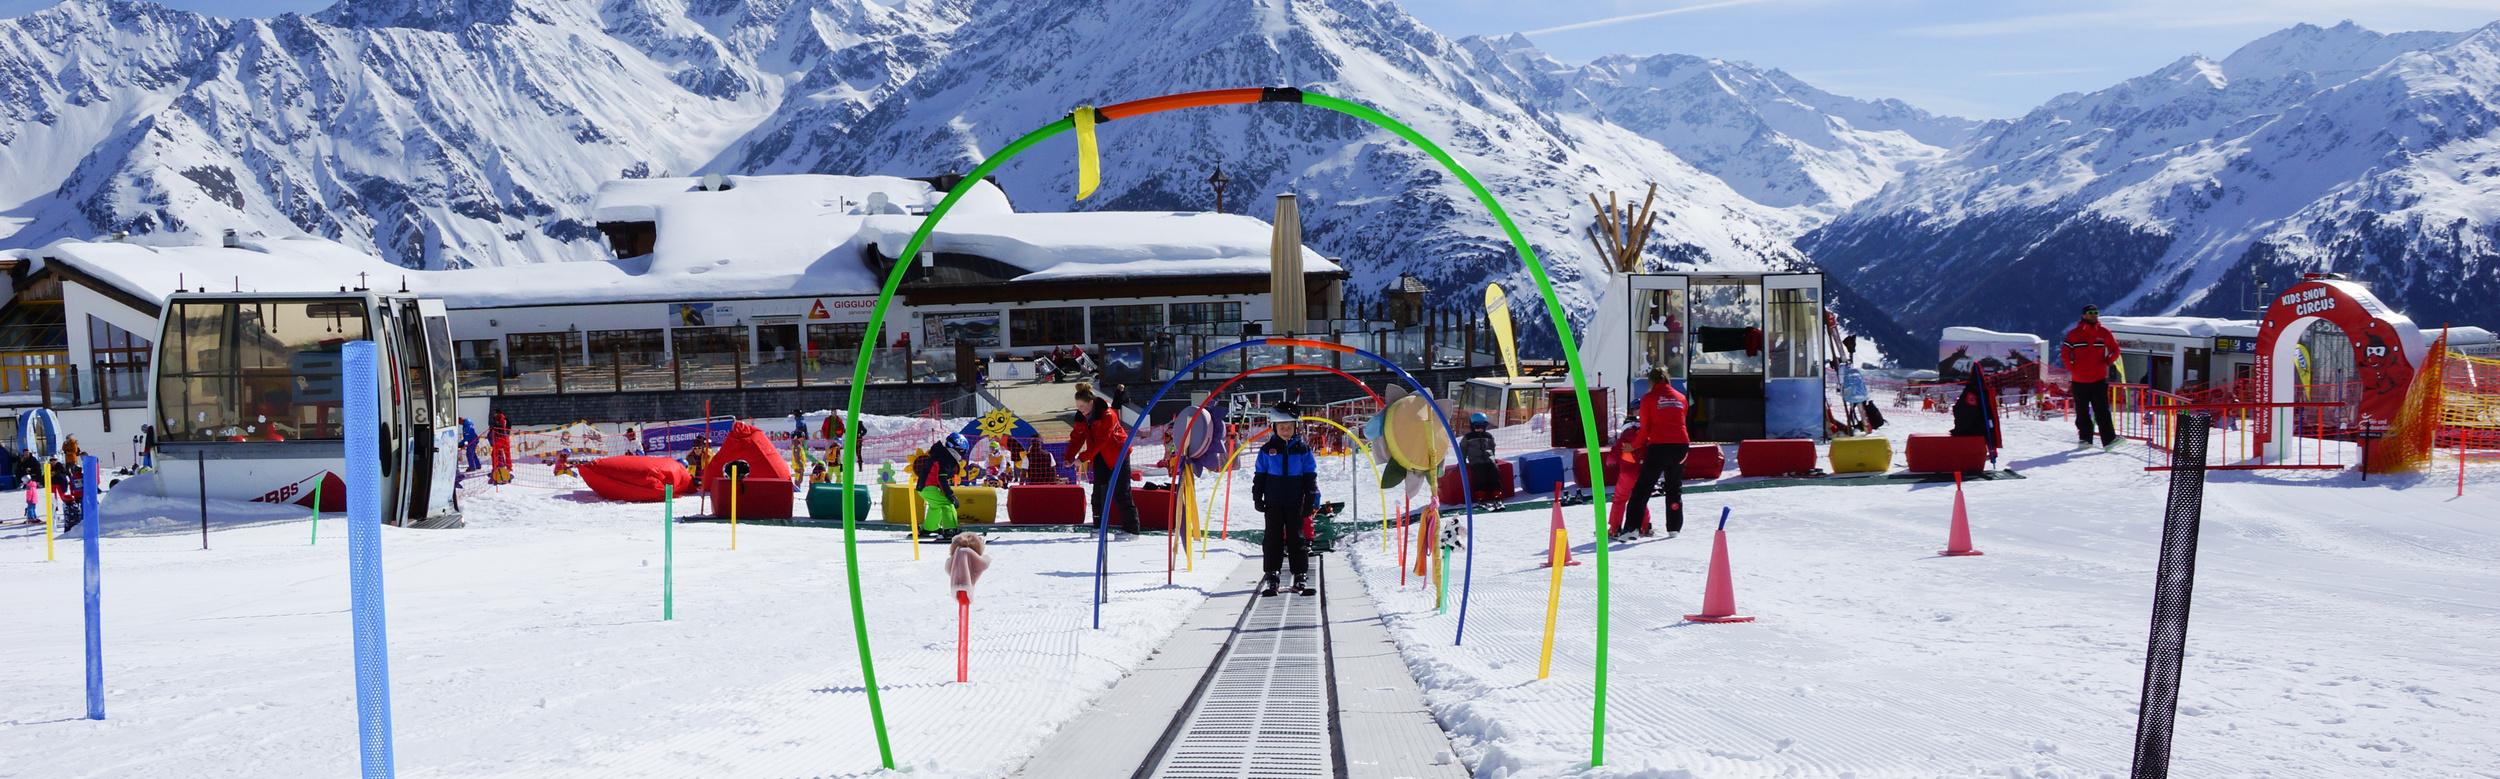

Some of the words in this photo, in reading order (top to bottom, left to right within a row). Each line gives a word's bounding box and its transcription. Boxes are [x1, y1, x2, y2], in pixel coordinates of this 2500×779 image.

[834, 300, 879, 309] GIGGIJOC
[2281, 293, 2301, 306] KIDS
[2302, 287, 2327, 301] SNOW
[2296, 298, 2336, 315] CIRCUS
